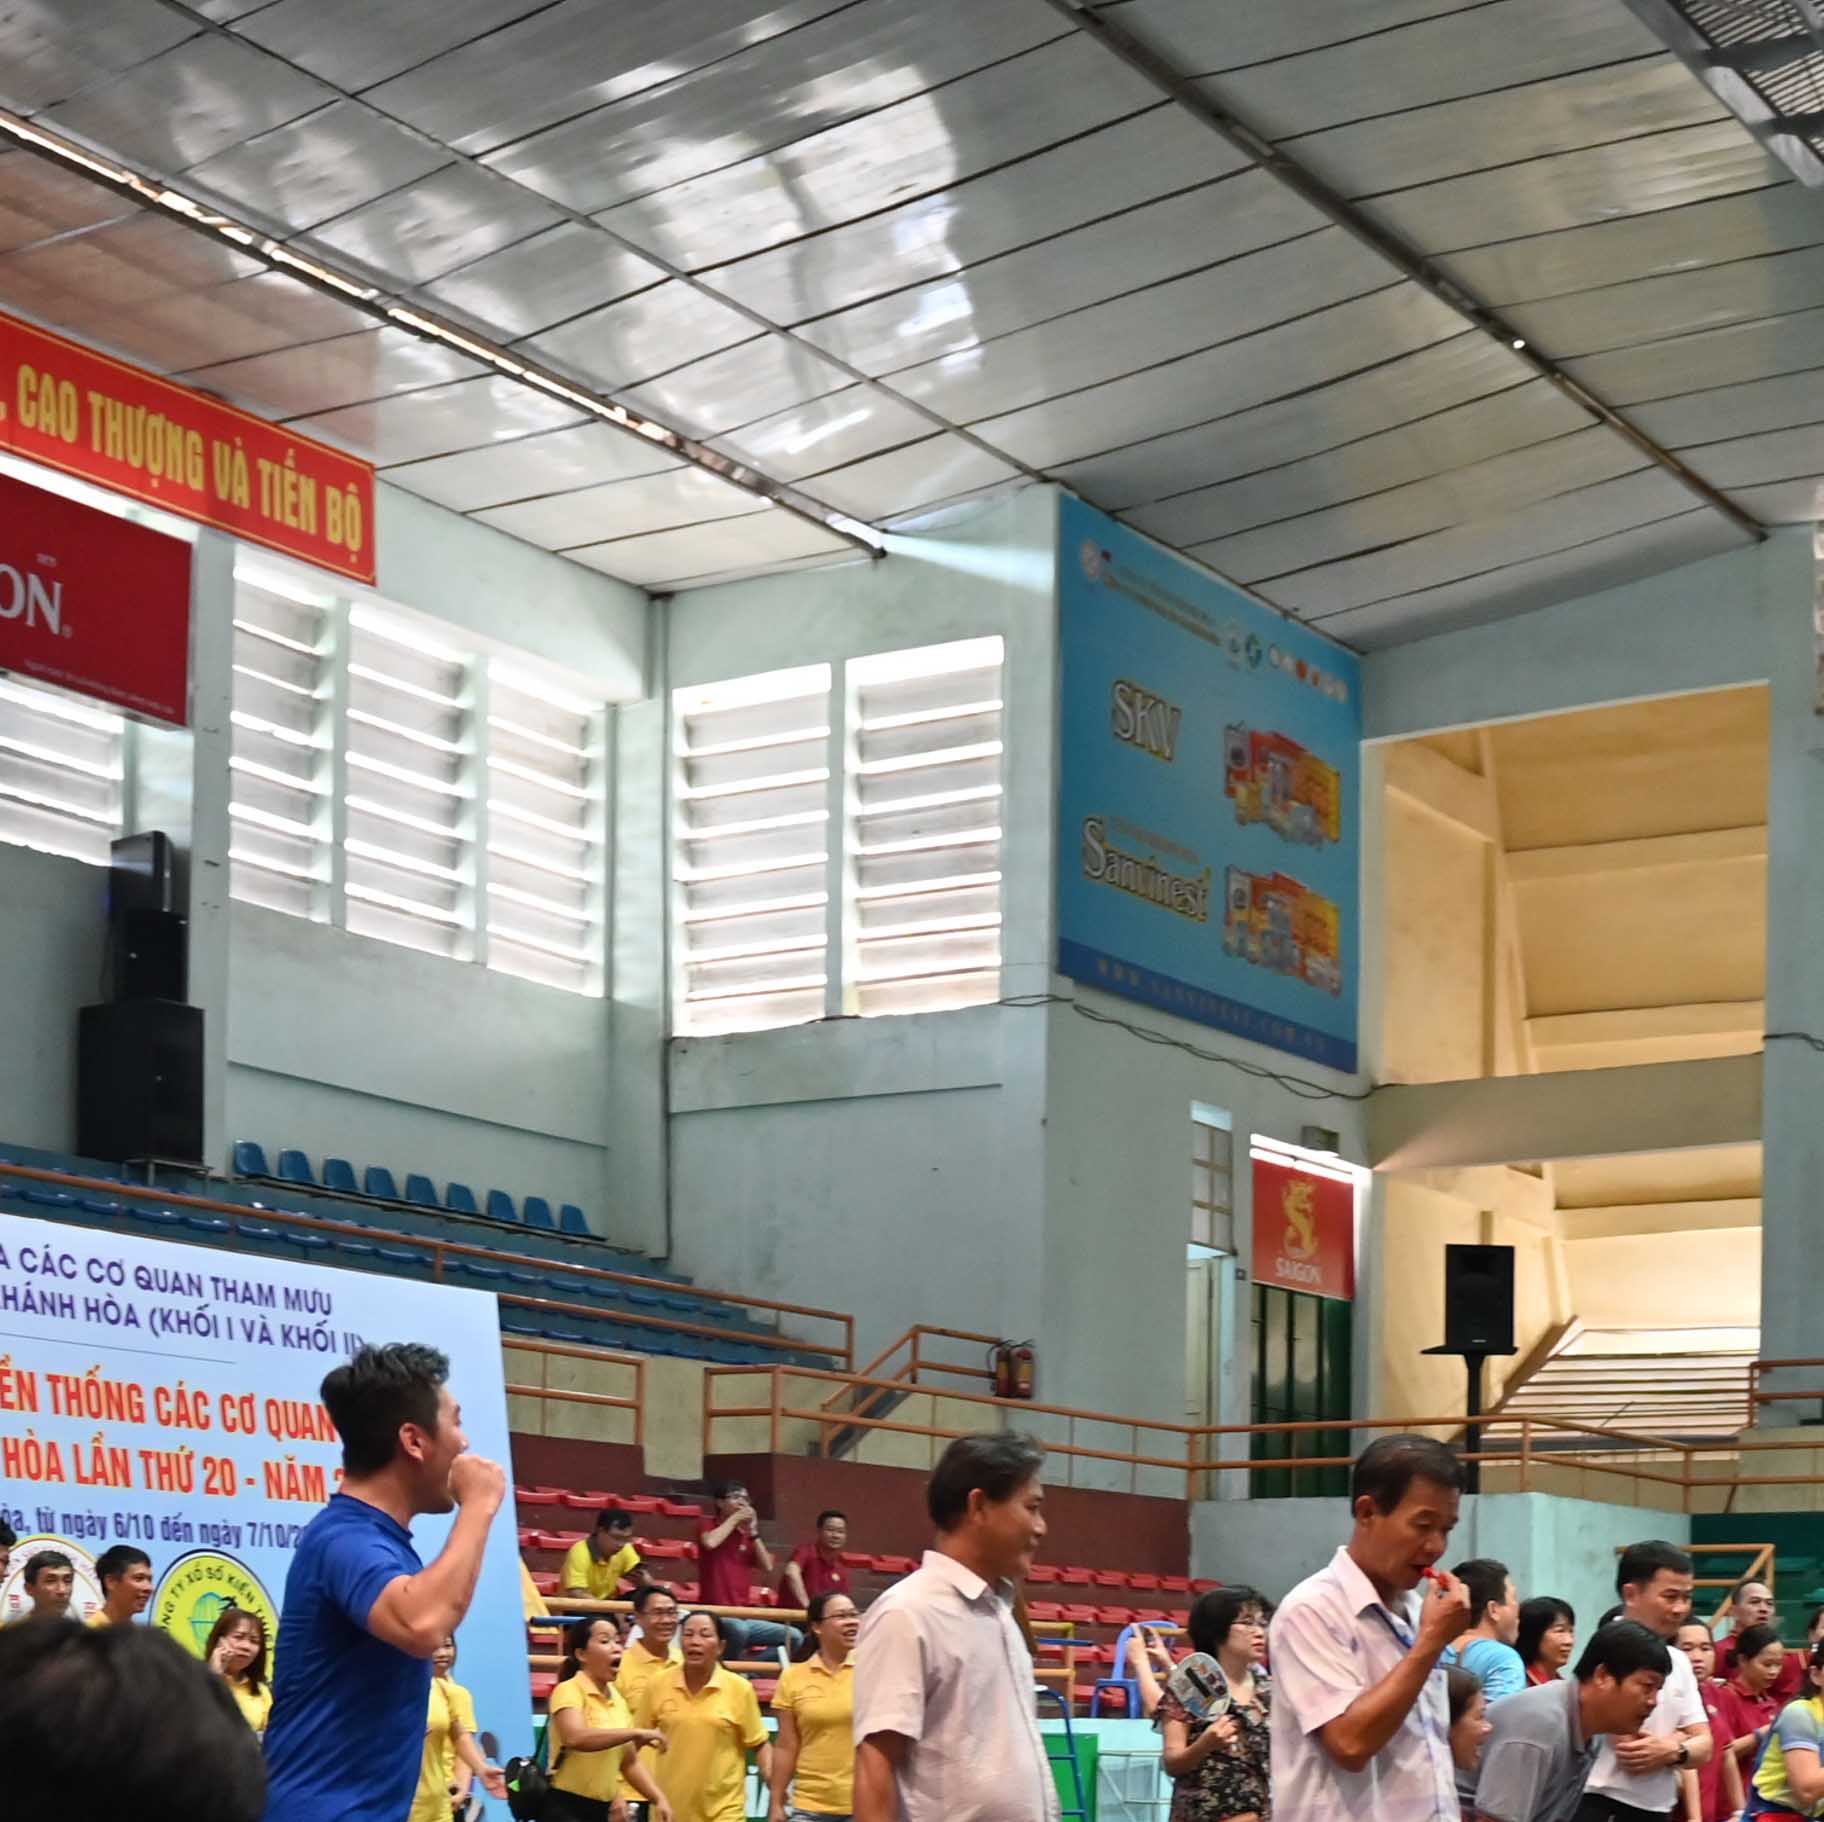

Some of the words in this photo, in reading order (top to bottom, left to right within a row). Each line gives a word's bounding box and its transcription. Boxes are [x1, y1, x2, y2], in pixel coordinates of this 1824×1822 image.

[18, 364, 79, 444] CAO
[87, 389, 205, 492] THƯỢNG
[213, 437, 251, 510] VÀ
[257, 448, 318, 536] TIẾN
[325, 482, 363, 564] BỘ
[19, 1243, 77, 1280] CÁC
[86, 1257, 126, 1286] CƠ
[135, 1264, 202, 1298] QUAN
[210, 1276, 276, 1310] THAM
[284, 1283, 332, 1317] MƯU
[85, 1293, 140, 1329] HÒA
[149, 1302, 222, 1339] (KHỐI
[226, 1315, 234, 1341] I
[238, 1313, 274, 1346] VÀ
[281, 1318, 338, 1355] KHỐI
[46, 1365, 146, 1424] THỐNG
[155, 1376, 210, 1432] CÁC
[219, 1389, 257, 1435] CƠ
[265, 1398, 337, 1442] QUAN
[2, 1427, 66, 1484] HÒA
[74, 1431, 133, 1490] LẦN
[138, 1443, 196, 1495] THỨ
[201, 1455, 237, 1497] 20
[263, 1454, 327, 1503] NĂM
[36, 1507, 56, 1534] từ
[62, 1512, 107, 1540] ngày
[114, 1512, 155, 1541] 6/10
[160, 1515, 194, 1544] đến
[199, 1520, 242, 1548] ngày
